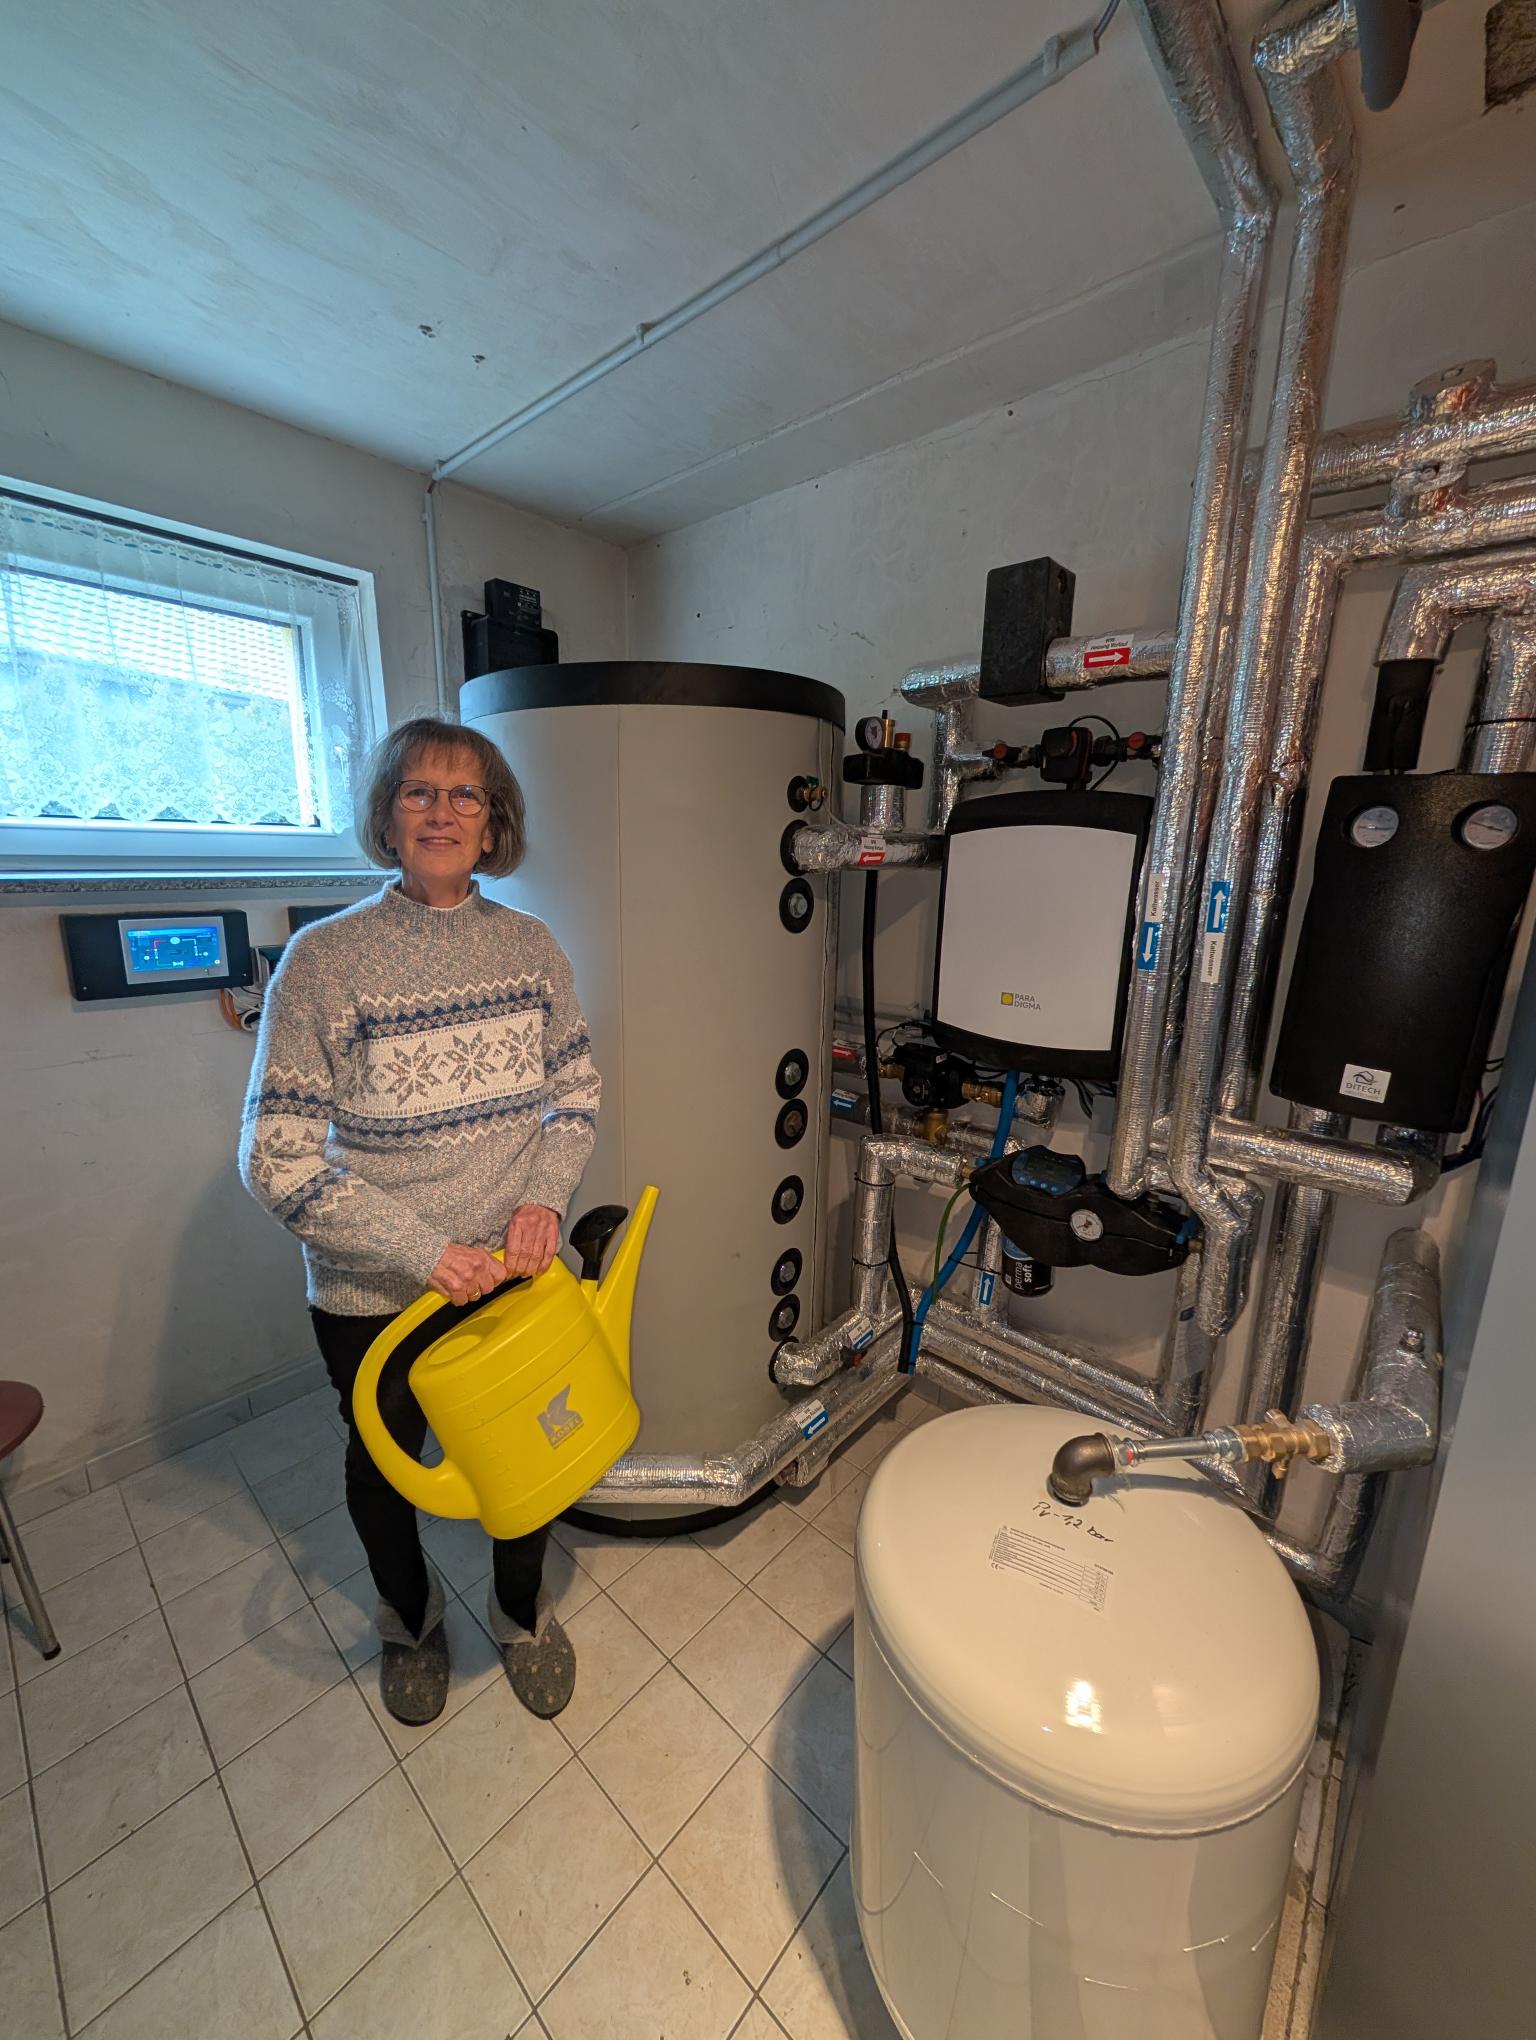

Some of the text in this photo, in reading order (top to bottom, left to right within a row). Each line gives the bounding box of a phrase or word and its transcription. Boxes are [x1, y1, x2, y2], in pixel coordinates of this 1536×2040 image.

[1151, 881, 1159, 917] Kaltwasser
[1208, 940, 1217, 977] Kaltwasser
[1014, 993, 1036, 1002] PARA
[1014, 1001, 1041, 1011] DIGMA
[1014, 1262, 1024, 1291] perma
[1024, 1264, 1032, 1283] soft
